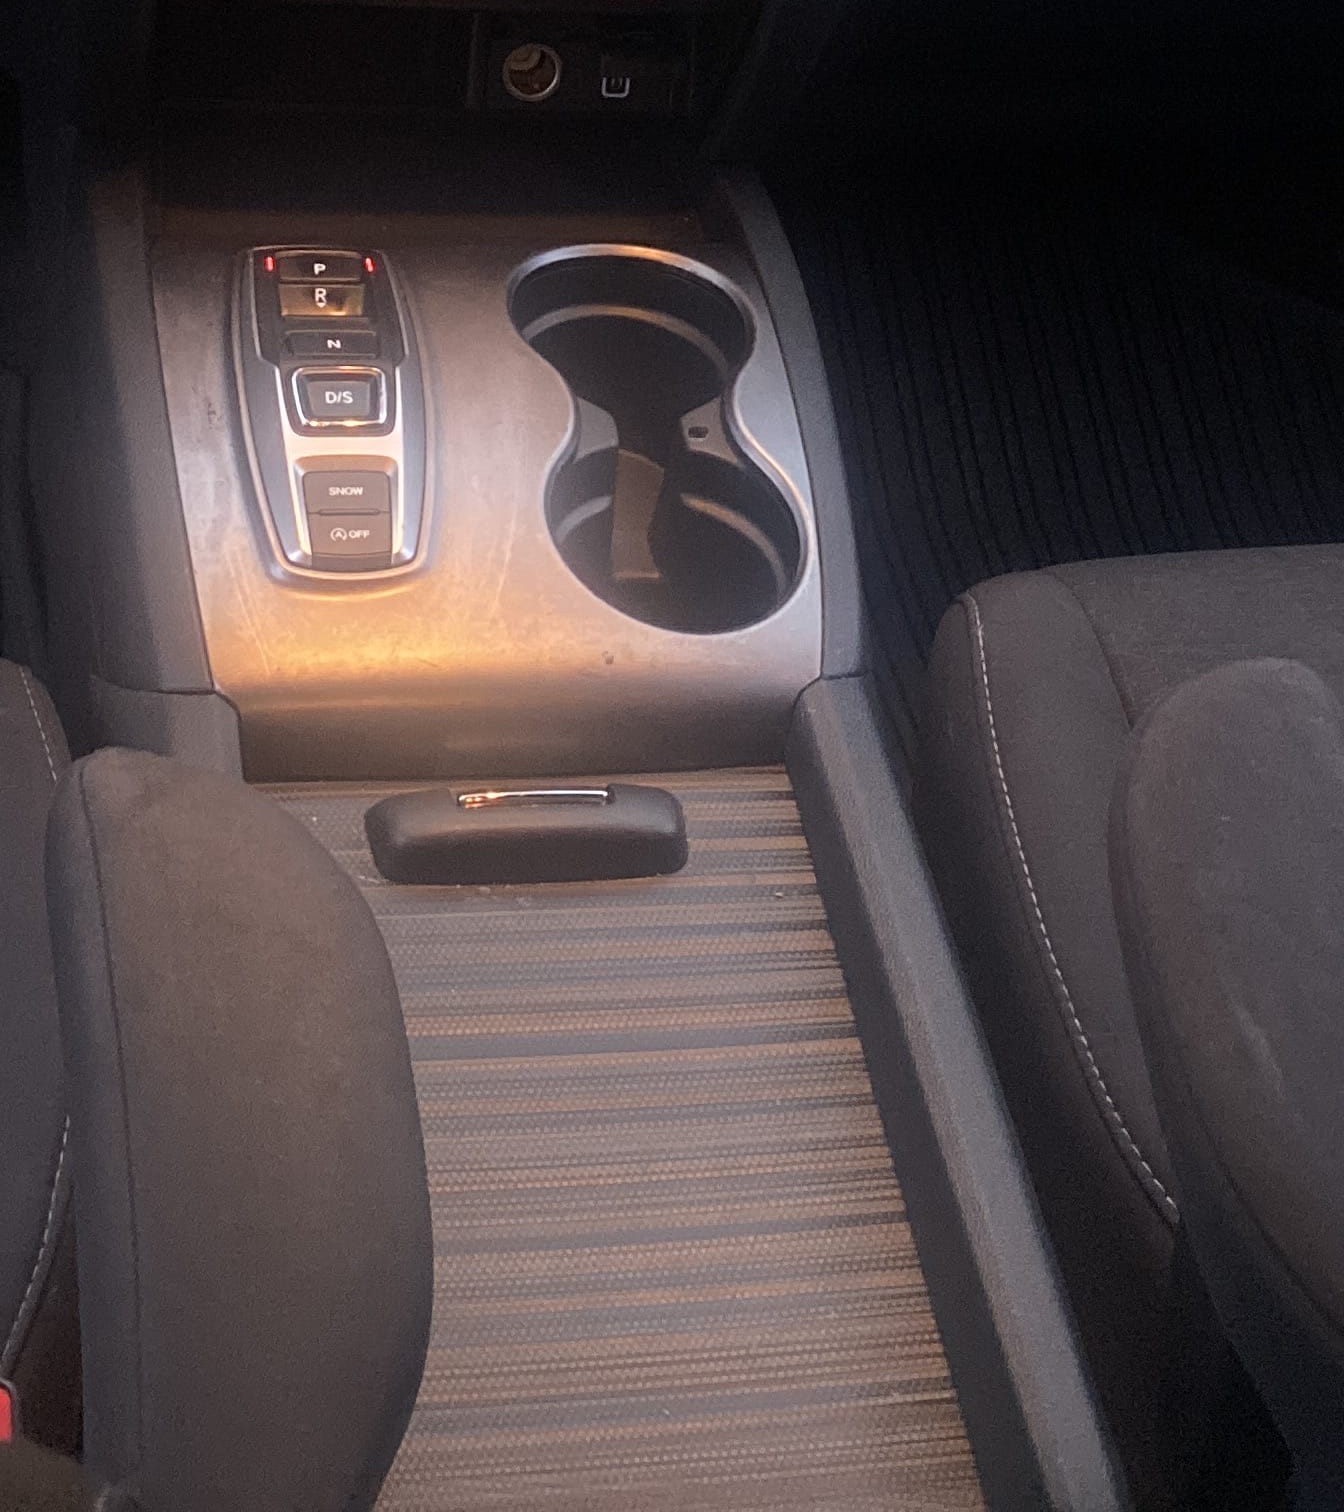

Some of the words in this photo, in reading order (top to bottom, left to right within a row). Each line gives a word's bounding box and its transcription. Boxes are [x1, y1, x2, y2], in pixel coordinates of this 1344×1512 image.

[313, 263, 326, 275] P
[314, 288, 327, 303] R
[327, 340, 341, 349] N
[325, 391, 354, 405] D/S
[328, 486, 363, 496] SNOW
[348, 529, 370, 539] OFF
